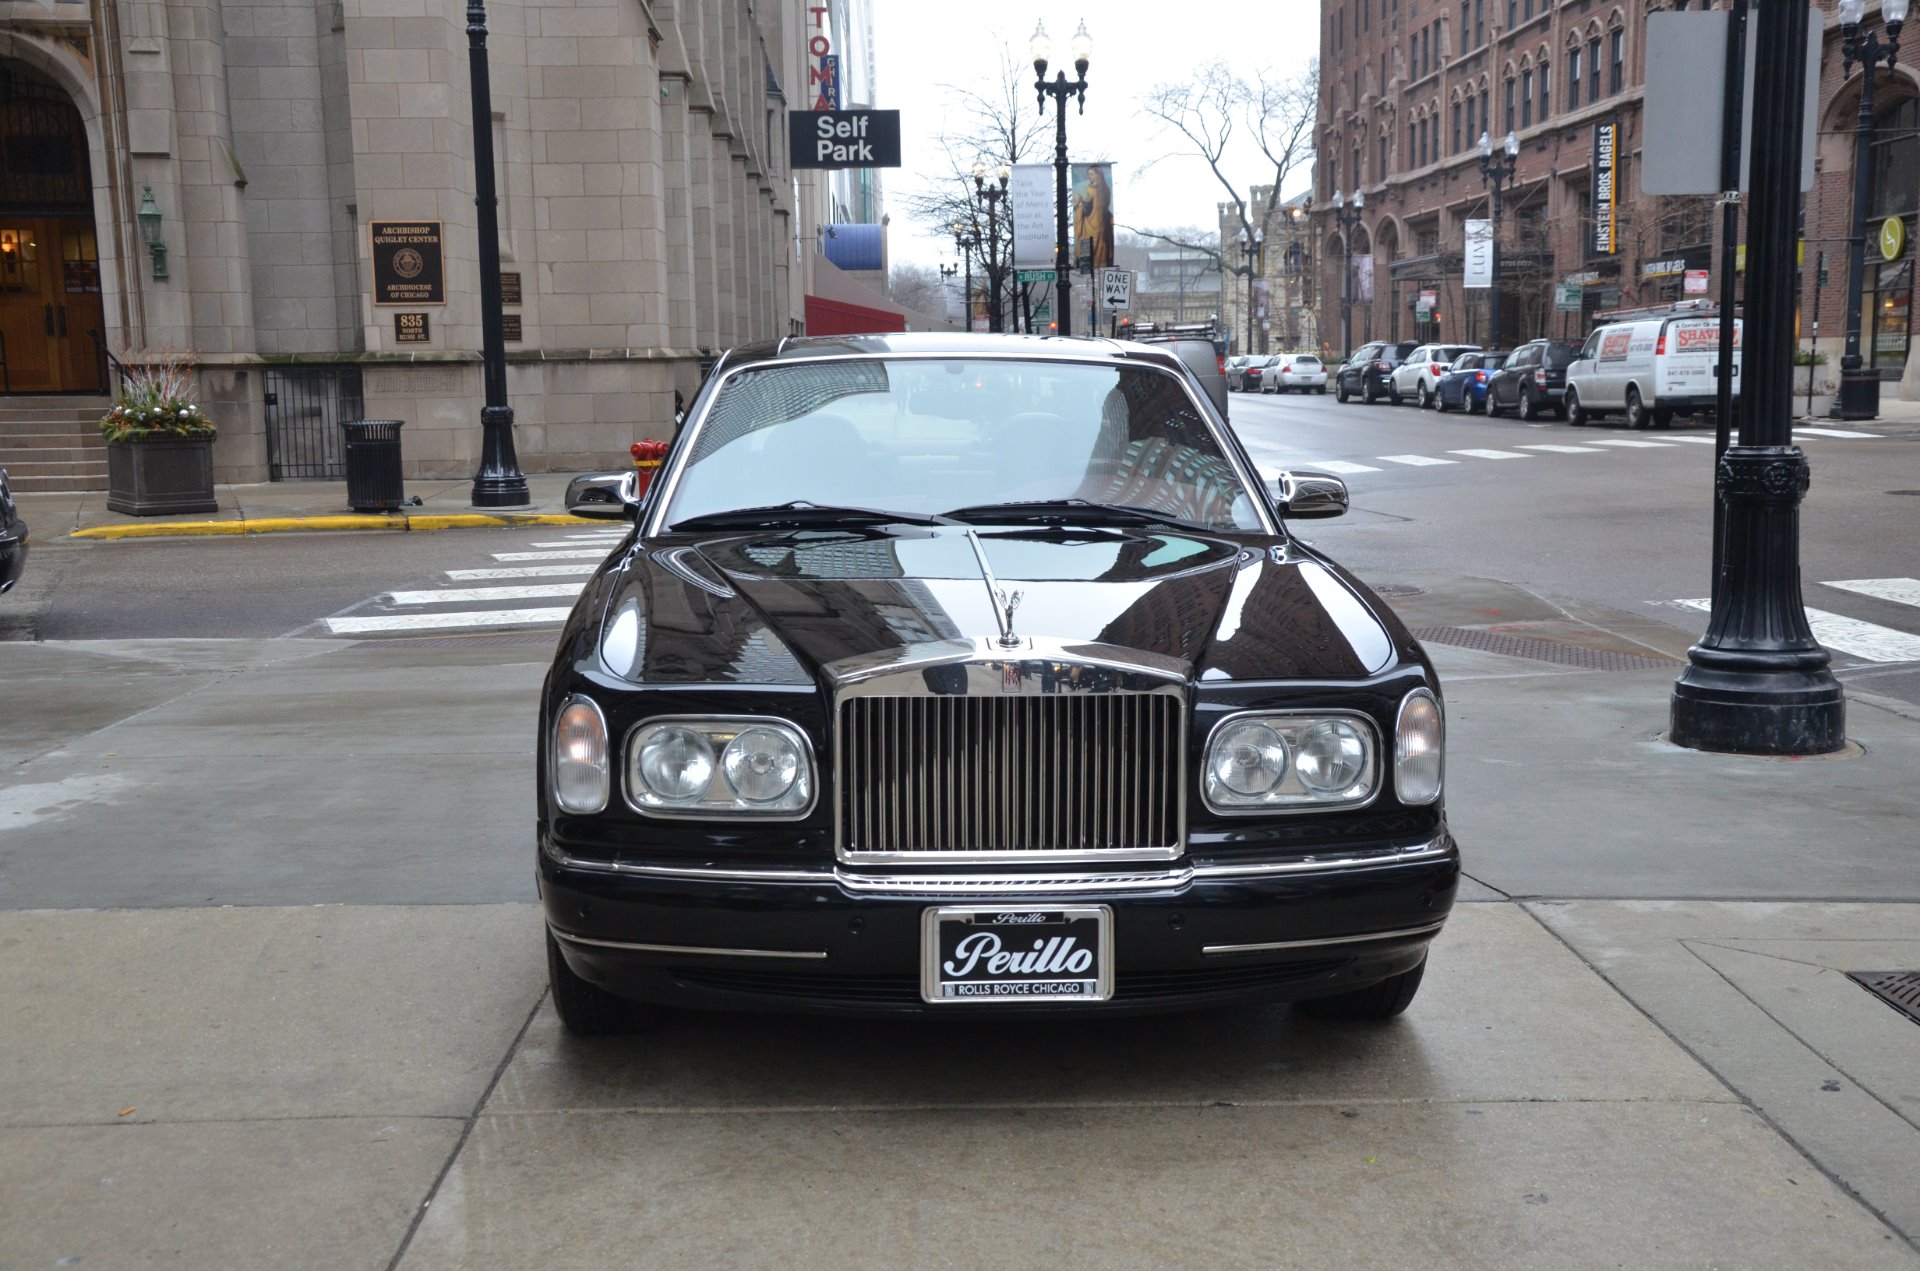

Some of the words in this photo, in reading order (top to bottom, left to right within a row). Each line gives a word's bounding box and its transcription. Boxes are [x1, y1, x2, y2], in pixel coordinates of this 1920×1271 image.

[827, 57, 837, 110] GHIRA
[817, 115, 868, 138] Self
[817, 139, 874, 161] Park
[1599, 125, 1613, 167] BAGELS
[1015, 190, 1029, 198] the
[1016, 201, 1025, 209] of
[1026, 201, 1049, 209] Mercy
[1016, 211, 1032, 219] tour
[1017, 222, 1030, 230] the
[1597, 203, 1611, 251] EINSTEIN
[375, 236, 407, 244] QUIGLEY
[1018, 232, 1049, 240] Institute
[1024, 272, 1046, 281] RUSH
[1107, 273, 1128, 283] ONE
[1106, 284, 1128, 294] WAY
[401, 314, 423, 327] 835
[1679, 328, 1739, 347] SHAVIZ
[992, 912, 1046, 924] Perillo
[943, 932, 1093, 977] Perillo
[958, 984, 991, 995] ROLLS
[994, 984, 1029, 994] ROYCE
[1032, 983, 1080, 993] CHICAGO
